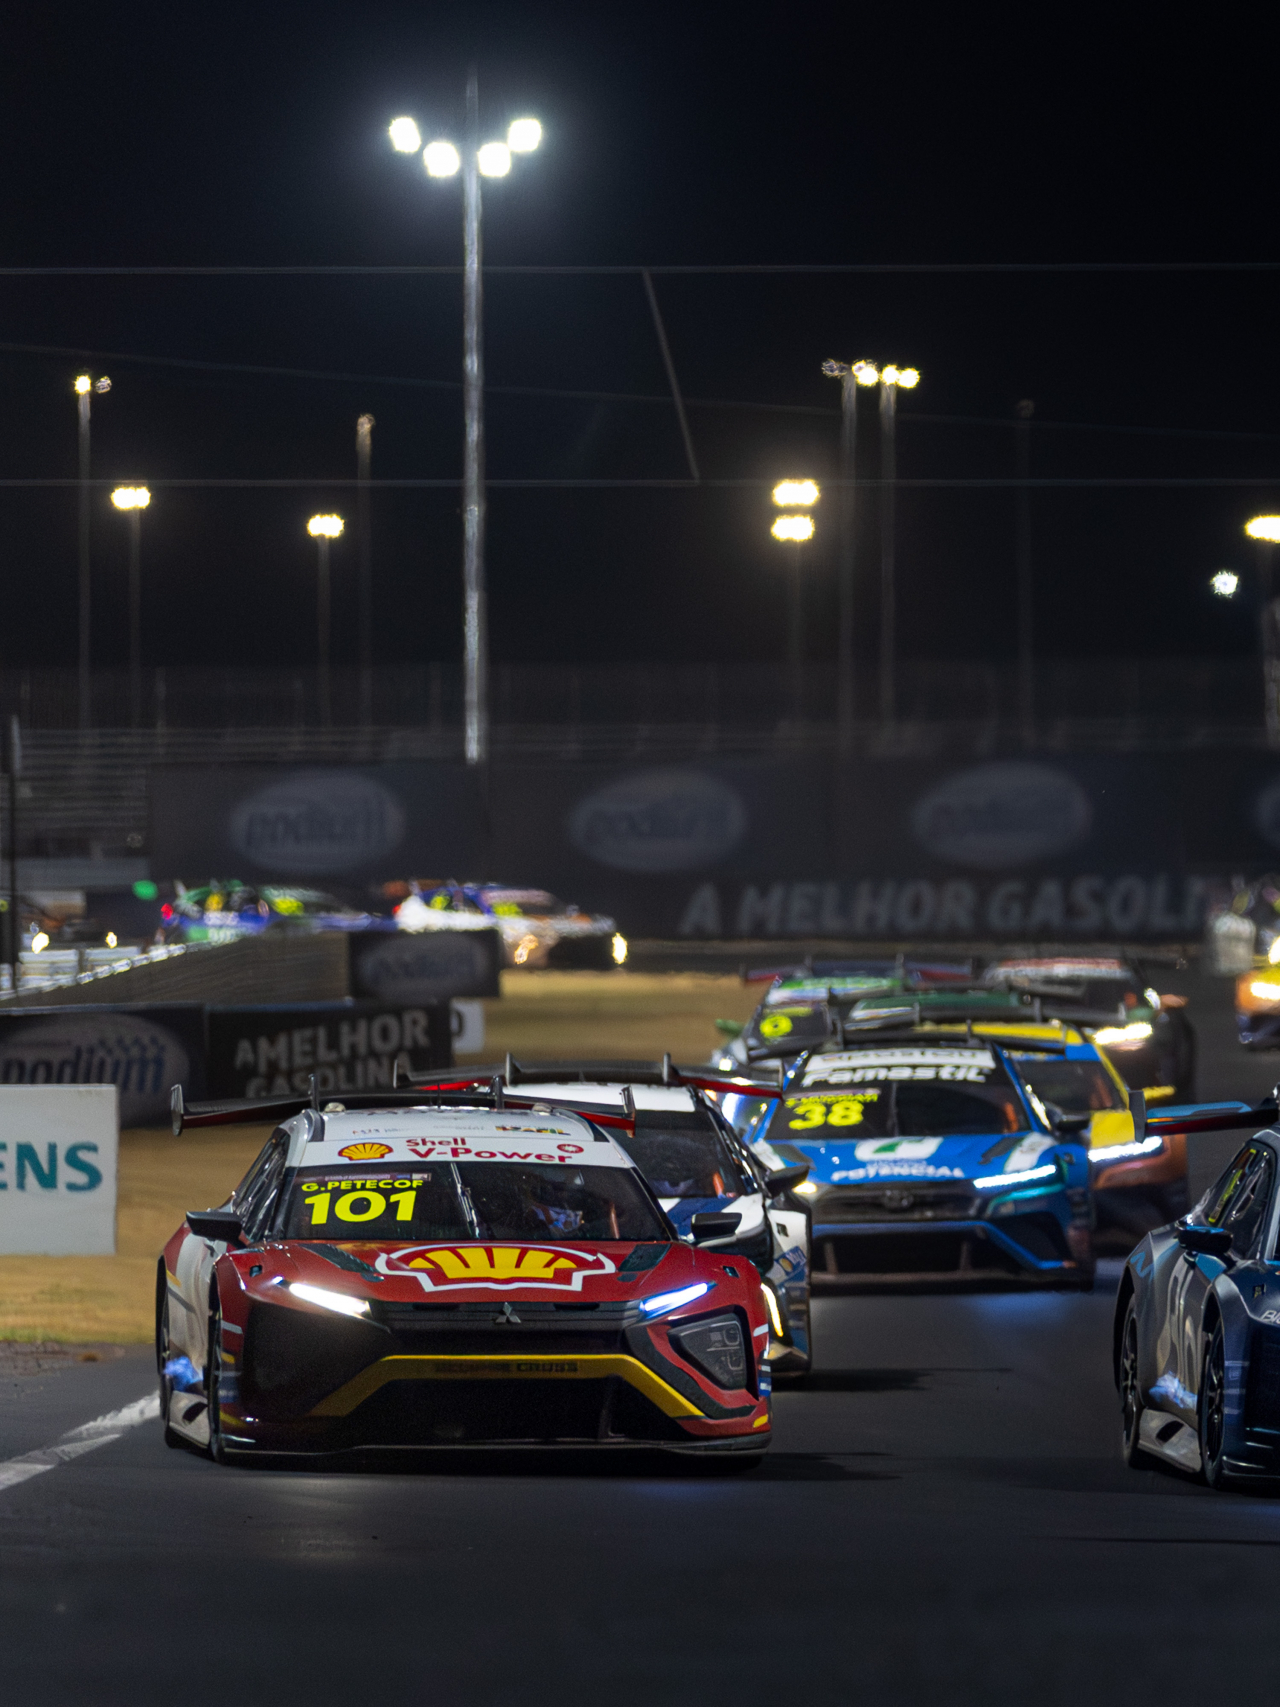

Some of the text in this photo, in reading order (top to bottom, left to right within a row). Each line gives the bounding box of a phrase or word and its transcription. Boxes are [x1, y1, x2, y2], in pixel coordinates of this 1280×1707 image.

[678, 875, 1208, 934] A MELHOR GASOLI
[234, 1009, 429, 1075] A MELHOR
[789, 1100, 864, 1130] 38
[406, 1138, 466, 1147] Shell
[409, 1147, 573, 1163] V-Power
[0, 1141, 103, 1192] NS
[305, 1190, 416, 1225] 101
